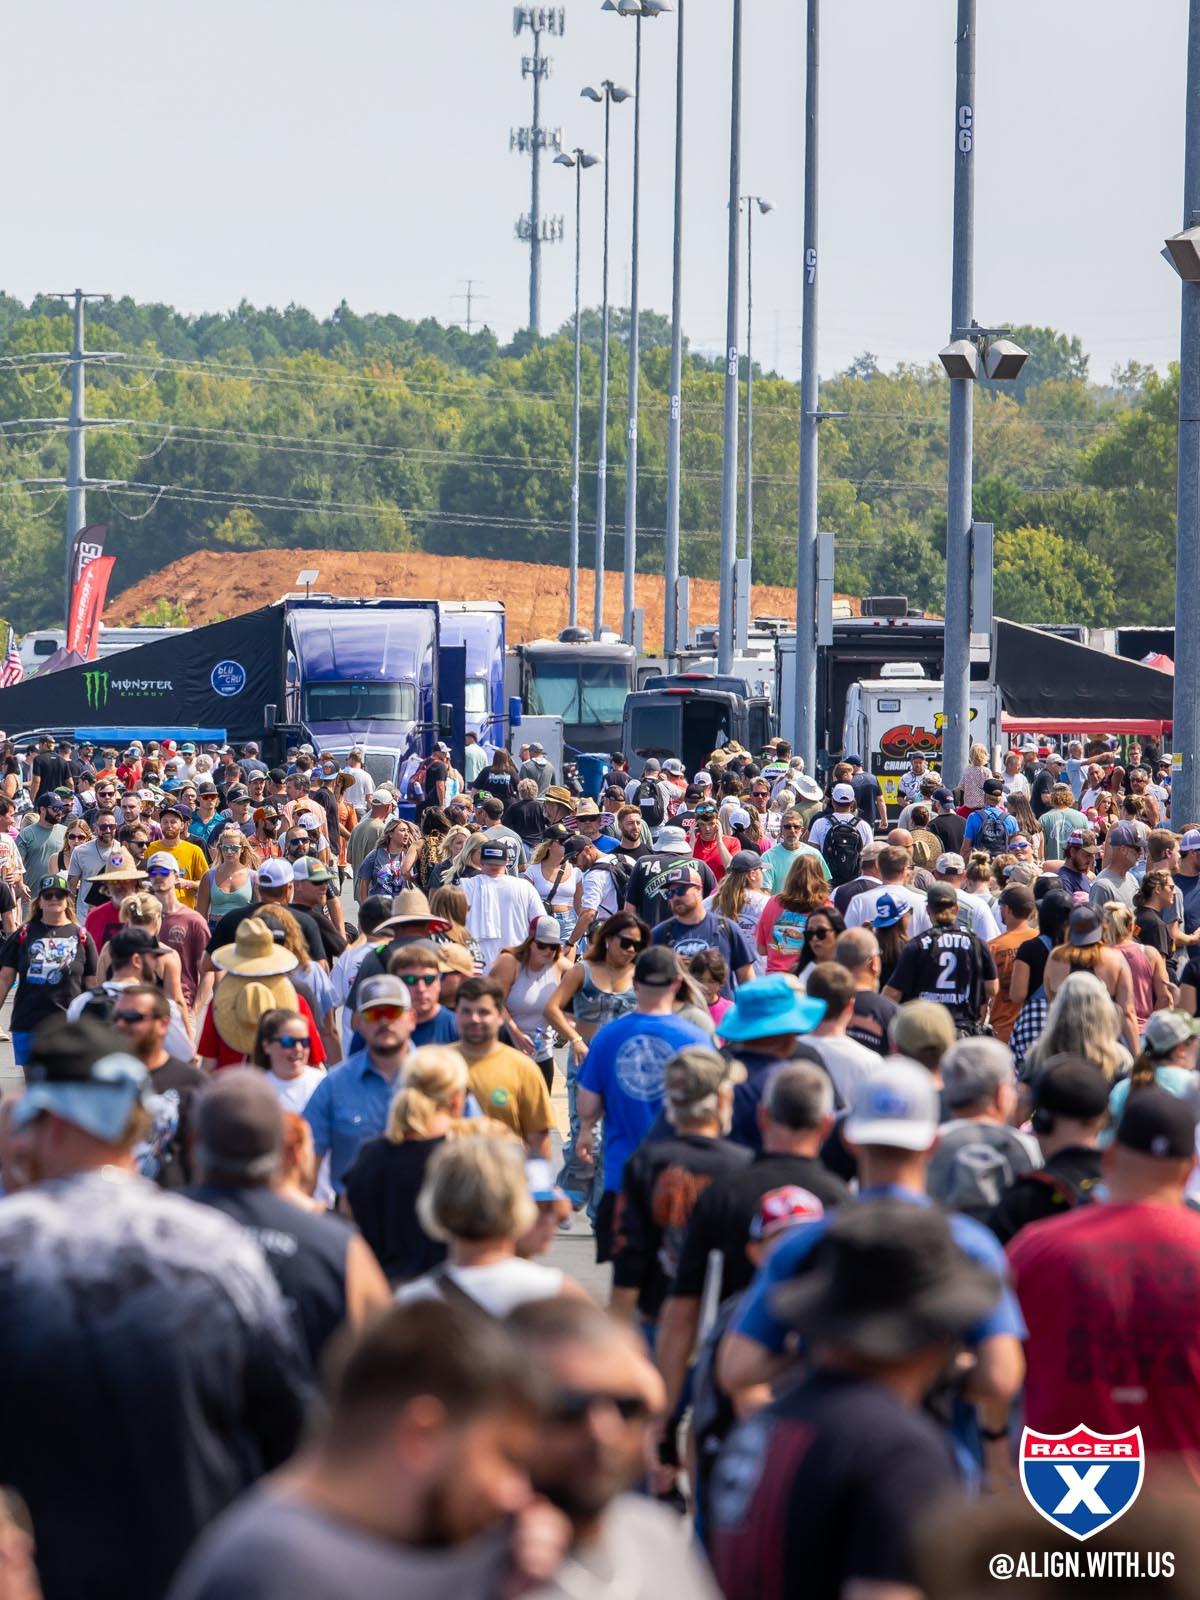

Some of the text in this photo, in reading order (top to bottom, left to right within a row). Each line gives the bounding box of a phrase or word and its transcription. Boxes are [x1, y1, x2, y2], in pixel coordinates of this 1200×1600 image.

[959, 105, 972, 152] C6
[806, 248, 817, 284] C7
[728, 346, 737, 376] C8
[111, 679, 174, 691] MONSTER
[641, 861, 661, 876] 74
[877, 905, 891, 918] 3
[936, 952, 957, 989] 2
